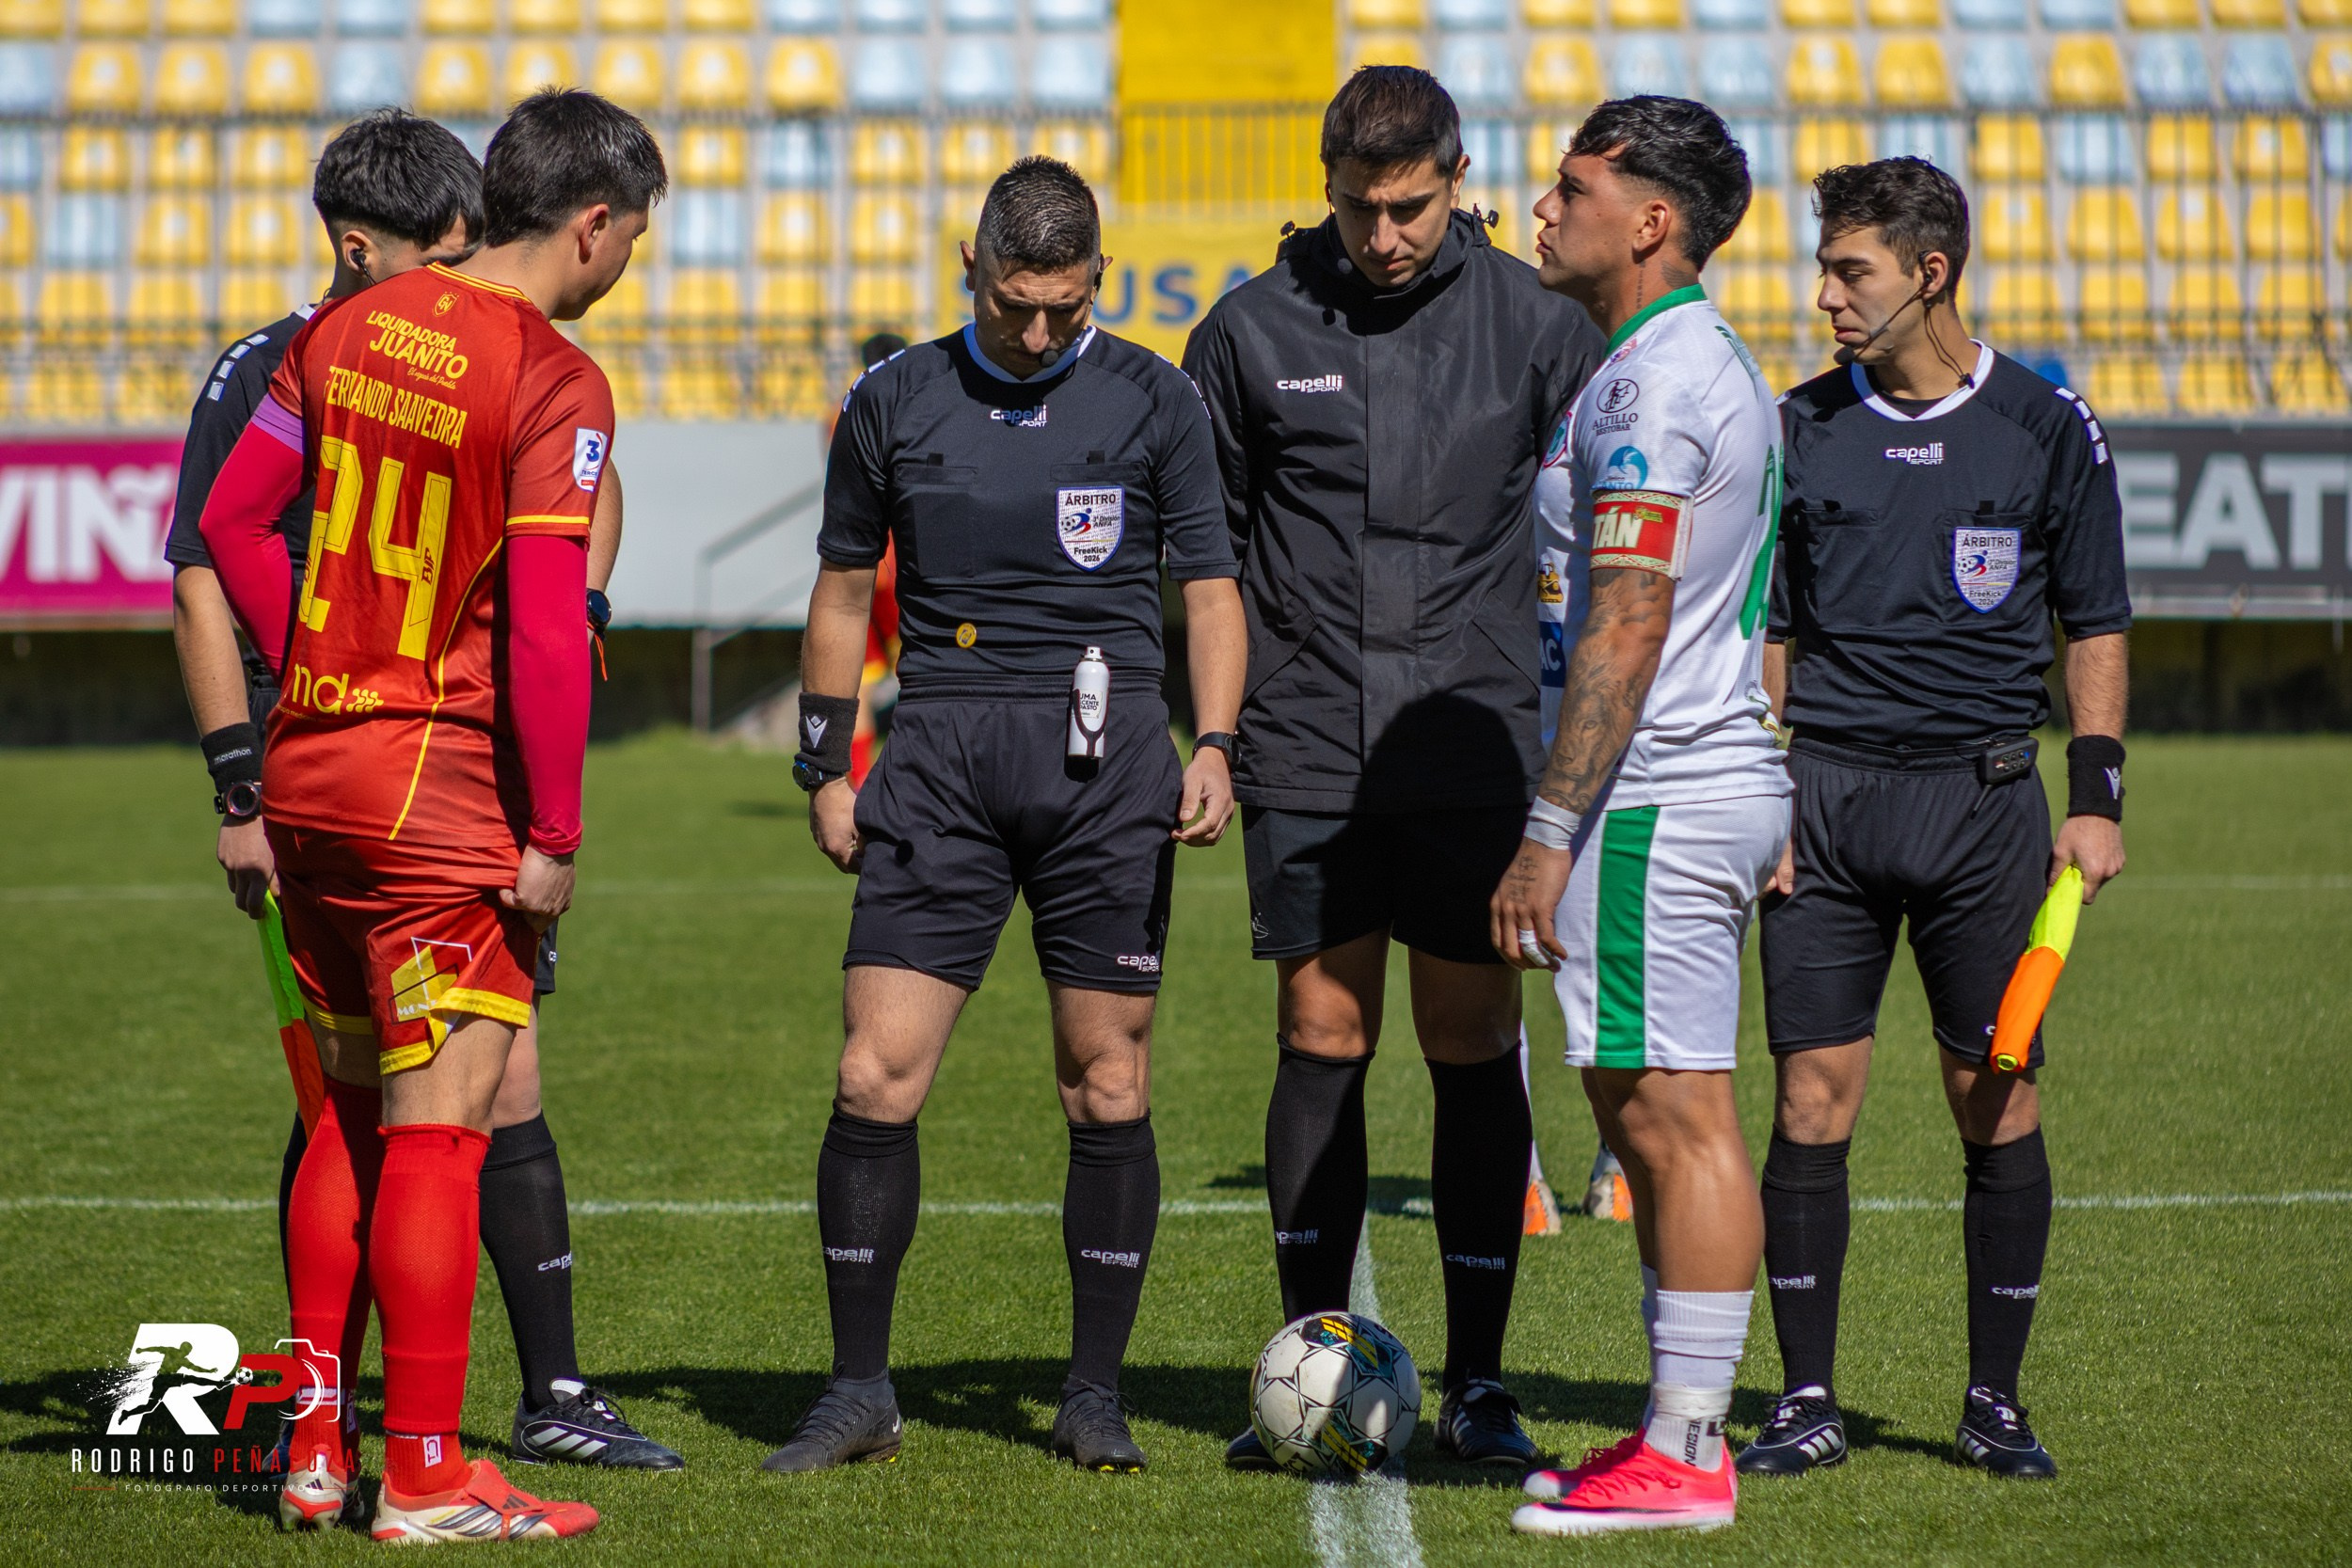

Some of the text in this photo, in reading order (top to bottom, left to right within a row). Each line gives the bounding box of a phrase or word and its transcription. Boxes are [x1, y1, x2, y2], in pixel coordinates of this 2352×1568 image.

[366, 310, 457, 351] LIQUIDADORA
[369, 329, 469, 379] JUANITO
[1277, 374, 1343, 392] capelli
[388, 388, 468, 449] SAAVEDRA
[990, 404, 1048, 423] capelli
[1592, 412, 1639, 430] ALTILLO
[586, 439, 600, 462] 3
[1885, 442, 1944, 462] capelli
[1065, 492, 1116, 505] ÁRBITRO
[2113, 451, 2352, 571] EAT
[298, 435, 452, 661] 24
[1963, 533, 2012, 547] ÁRBITRO
[1073, 546, 1107, 554] FreeKick
[214, 746, 252, 766] marathon
[1081, 1249, 1140, 1264] capelli
[1446, 1255, 1505, 1267] capelli
